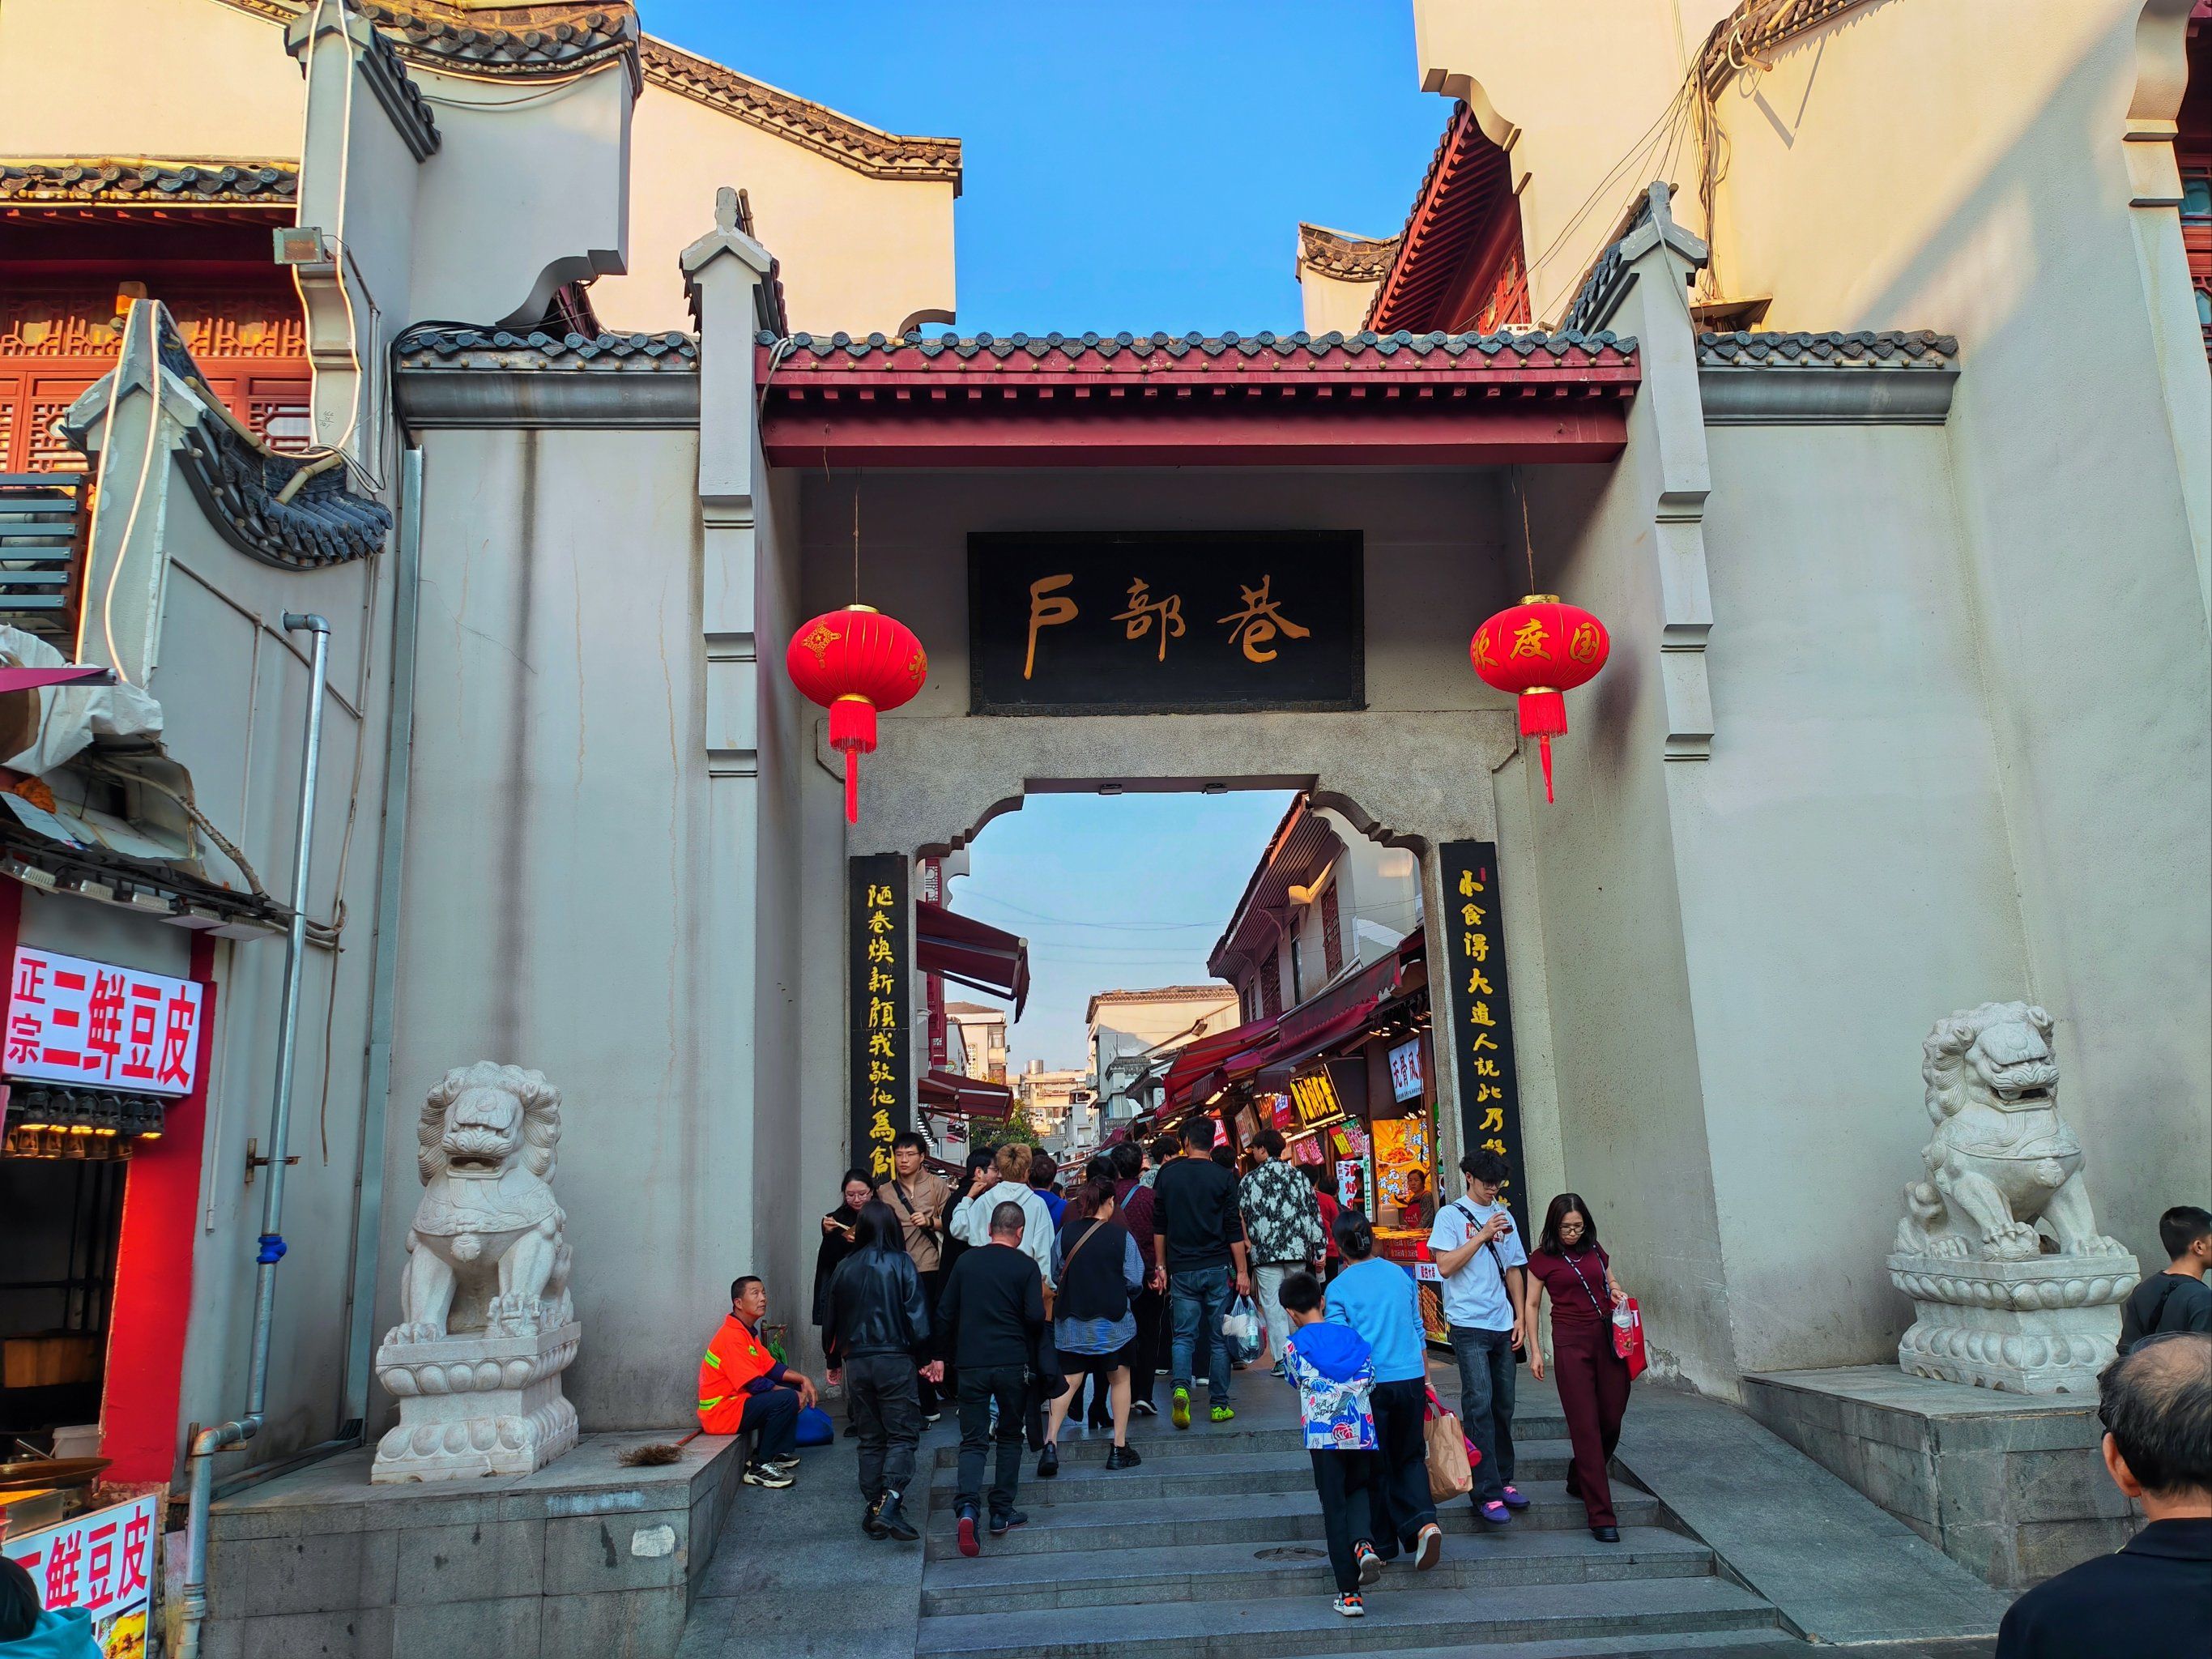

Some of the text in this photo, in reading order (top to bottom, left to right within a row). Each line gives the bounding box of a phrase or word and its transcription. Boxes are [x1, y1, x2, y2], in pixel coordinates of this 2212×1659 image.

[1023, 574, 1311, 680] 户部巷
[1472, 617, 1608, 672] 欢度国
[7, 957, 48, 1064] 正宗
[42, 969, 196, 1088] 三鲜豆皮
[13, 1505, 151, 1611] 鲜豆皮
